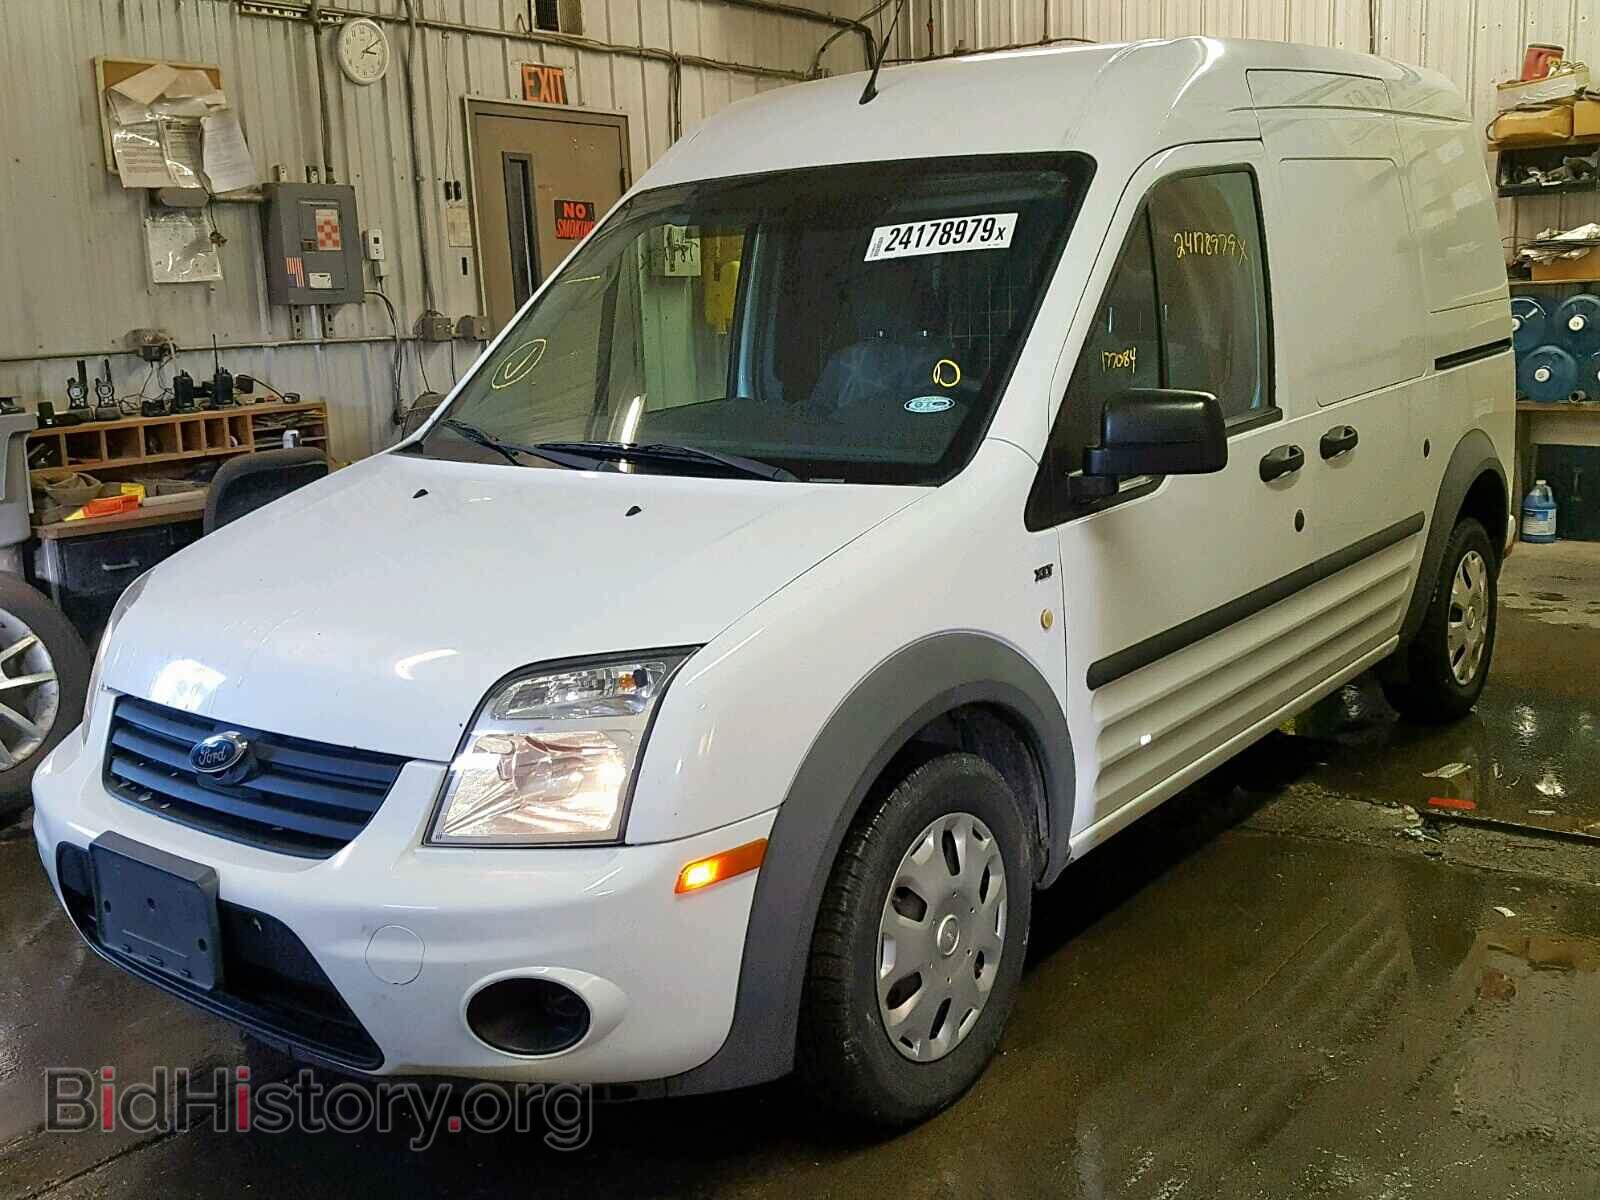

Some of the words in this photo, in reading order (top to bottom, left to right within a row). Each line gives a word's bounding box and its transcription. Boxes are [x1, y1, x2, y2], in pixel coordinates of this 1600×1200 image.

[523, 66, 563, 104] EXIT
[563, 202, 586, 219] NO
[198, 744, 226, 766] Ford
